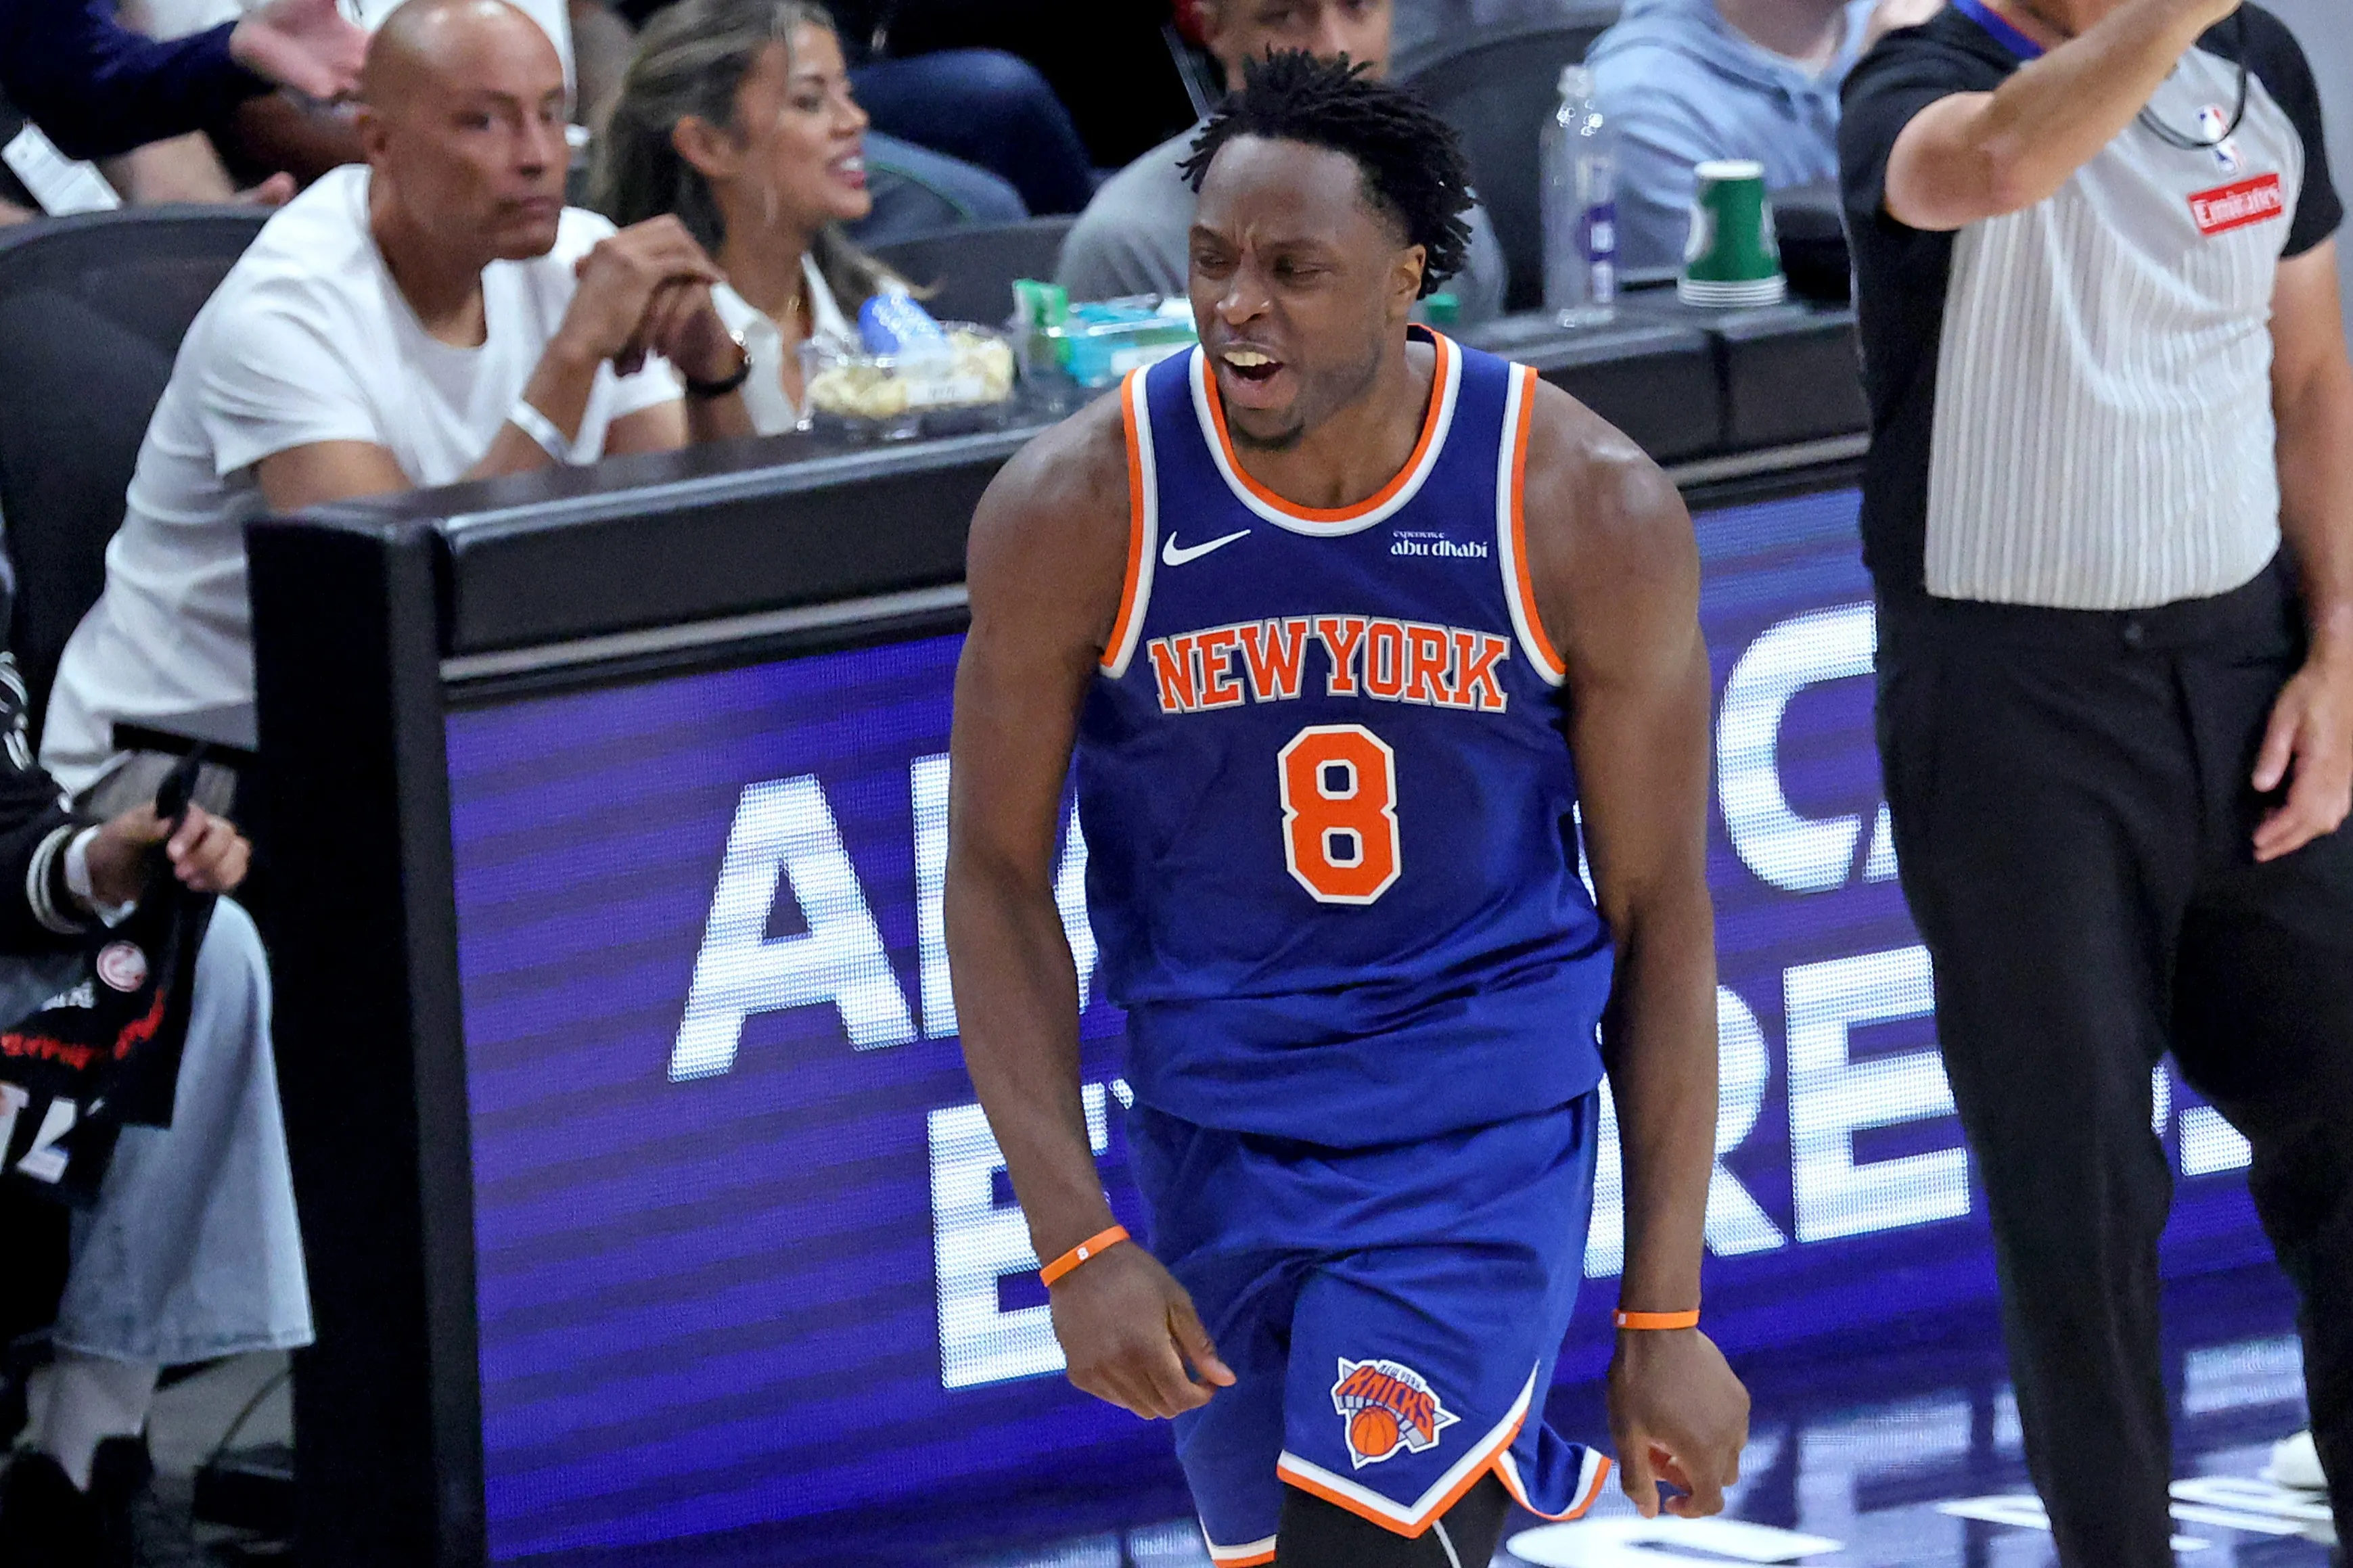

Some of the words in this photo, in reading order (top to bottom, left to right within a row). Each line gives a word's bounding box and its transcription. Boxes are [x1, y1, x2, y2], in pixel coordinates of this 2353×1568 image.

[1390, 539, 1429, 556] abu
[1432, 540, 1488, 558] dhabi
[1147, 616, 1310, 714] NEW
[1314, 614, 1511, 714] YORK
[1277, 724, 1401, 905] 8
[1335, 1365, 1434, 1442] KNICKS
